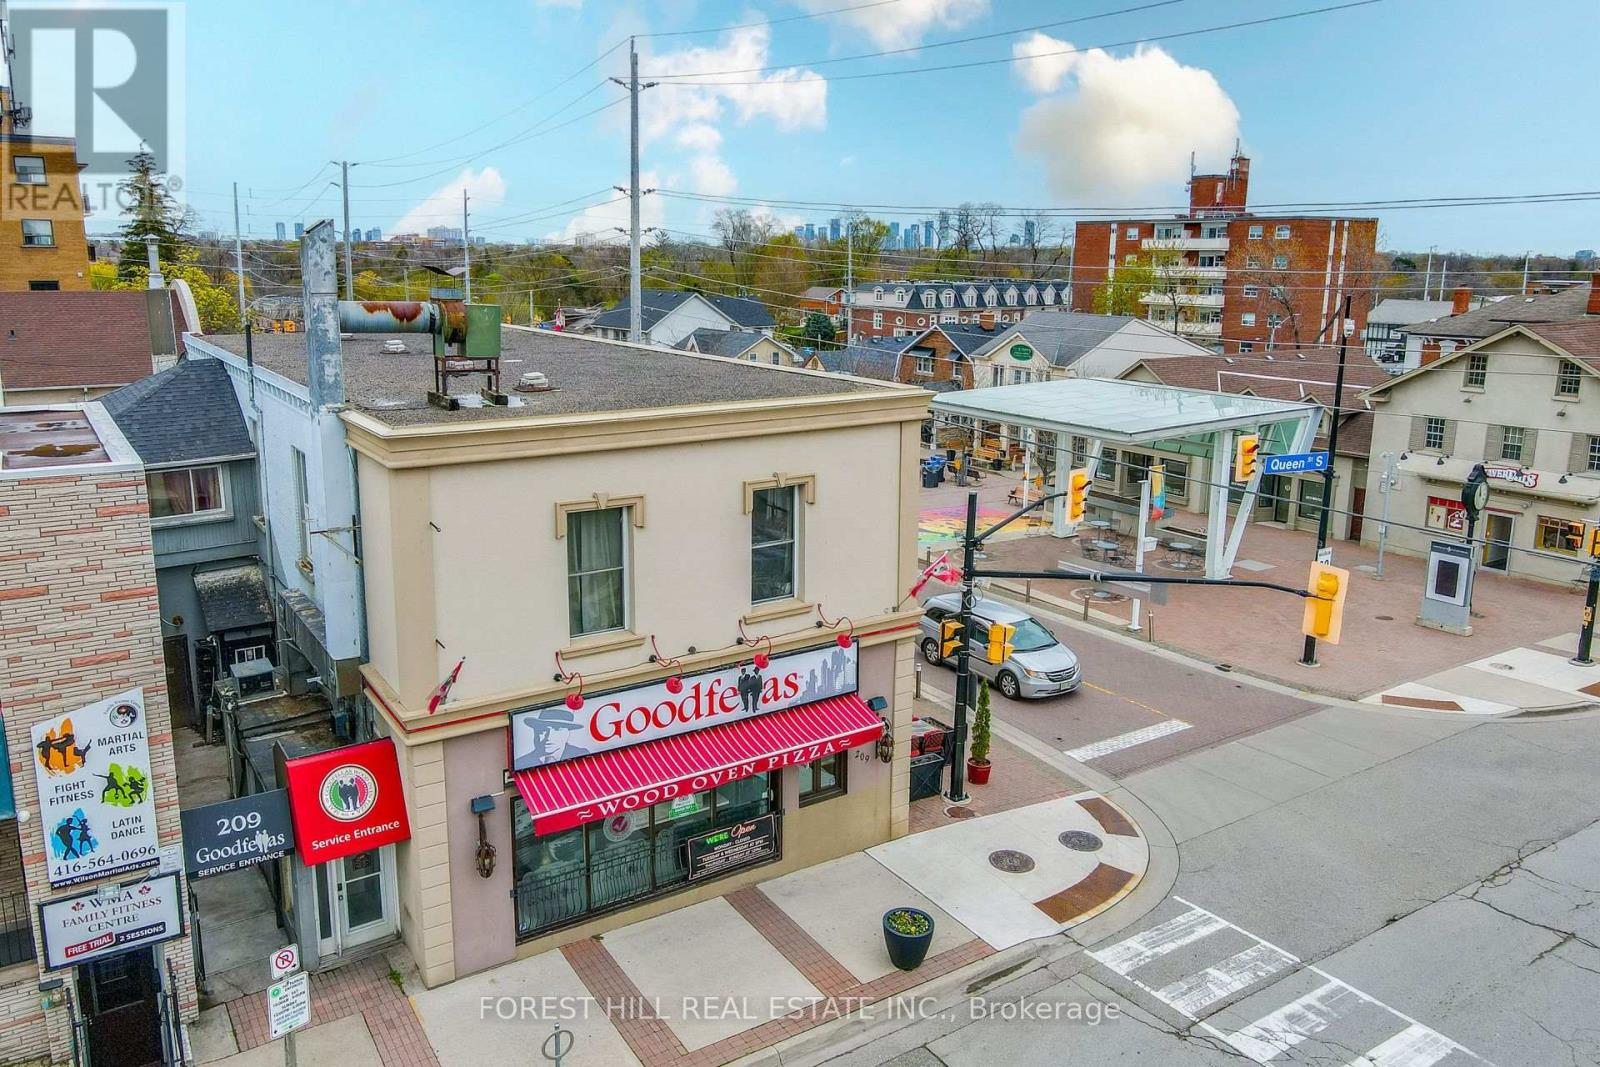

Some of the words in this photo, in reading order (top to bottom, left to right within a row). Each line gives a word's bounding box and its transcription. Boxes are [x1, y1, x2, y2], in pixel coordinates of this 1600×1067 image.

[1270, 458, 1305, 471] Queen
[1315, 455, 1323, 467] S
[589, 668, 799, 742] Goodfeas
[97, 731, 144, 747] MARTIAL
[108, 744, 137, 756] ARTS
[854, 749, 870, 763] 209
[598, 784, 679, 815] WOOD
[692, 762, 756, 790] OVEN
[766, 742, 836, 770] PIZZA
[54, 780, 87, 794] FIGHT
[49, 789, 95, 806] FITNESS
[112, 815, 142, 829] LATIN
[216, 811, 261, 836] 209
[110, 825, 146, 840] DANCE
[311, 833, 351, 850] Service
[353, 820, 400, 840] Entrance
[731, 823, 757, 839] Open
[196, 829, 285, 864] Goodfeas
[713, 842, 732, 851] MONDAY
[53, 845, 156, 878] 416-564-0696
[198, 861, 236, 877] SERVICE
[239, 850, 285, 868] ENTRANCE
[702, 853, 720, 862] TUESDAY
[62, 909, 109, 928] FAMILY
[112, 897, 162, 916] FITNESS
[88, 914, 139, 933] CENTRE
[126, 925, 164, 939] SESSIONS
[67, 942, 88, 956] FREE
[90, 935, 112, 949] TRIAL
